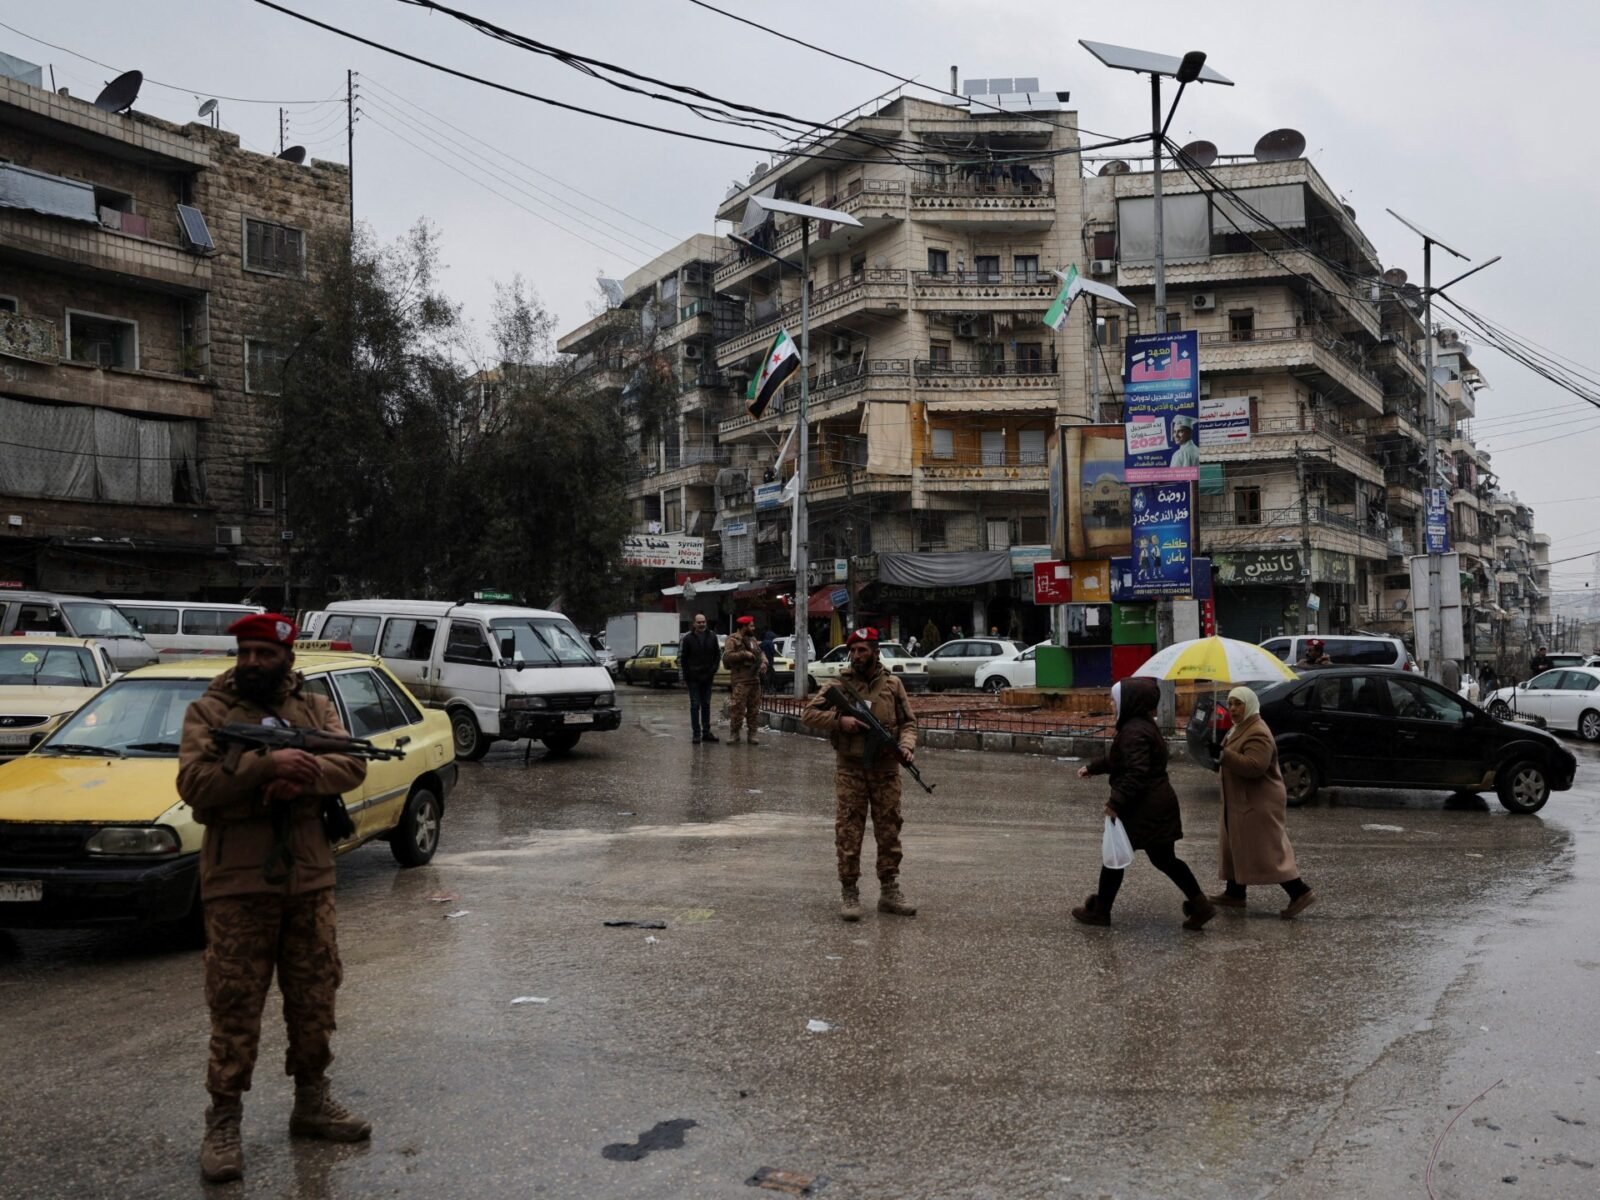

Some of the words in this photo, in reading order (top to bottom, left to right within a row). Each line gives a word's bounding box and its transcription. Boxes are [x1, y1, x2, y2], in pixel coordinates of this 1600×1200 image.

[1147, 348, 1171, 357] معهد
[1131, 394, 1151, 403] لدورات
[1150, 393, 1173, 402] التسجيل
[1173, 391, 1192, 402] افتتاح
[1128, 404, 1147, 414] التاسع
[1174, 402, 1195, 410] العلمي
[1130, 423, 1153, 433] التسجيل
[1130, 435, 1165, 449] 2027
[1157, 490, 1186, 503] روضة
[1161, 538, 1188, 549] طفلك
[1165, 549, 1186, 565] بأمان
[1245, 554, 1295, 577] تاتش
